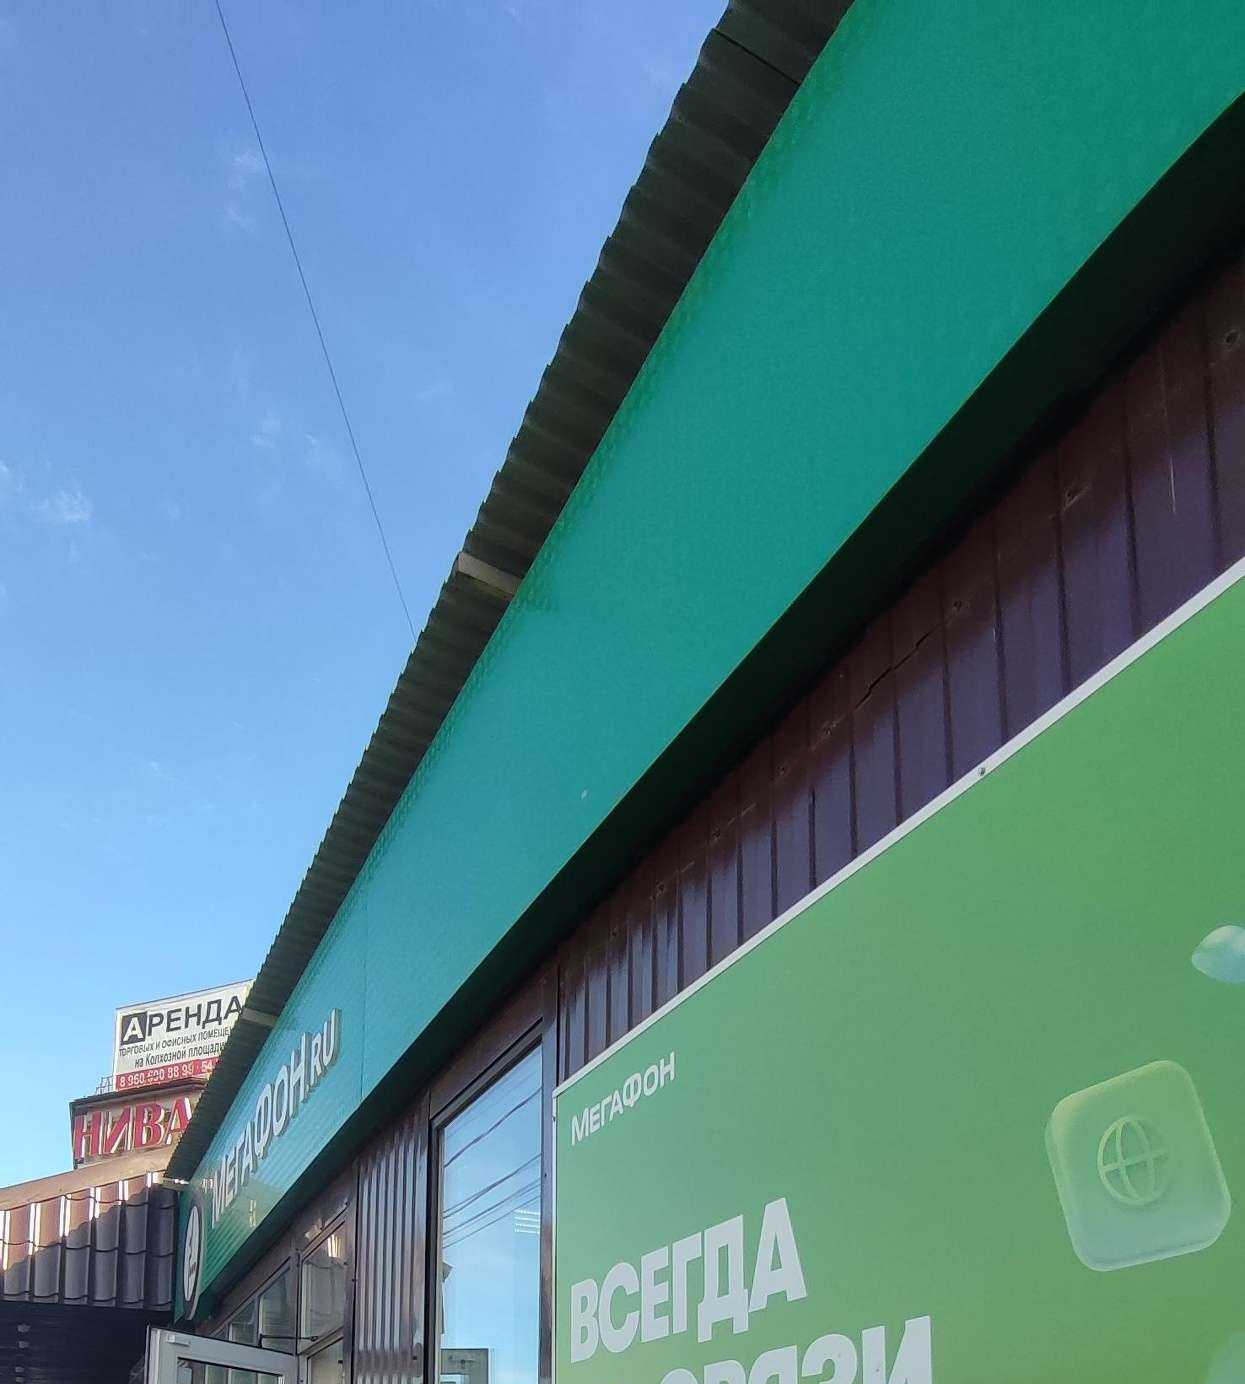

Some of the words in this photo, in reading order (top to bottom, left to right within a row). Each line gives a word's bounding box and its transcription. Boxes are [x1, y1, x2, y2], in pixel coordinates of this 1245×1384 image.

[121, 995, 242, 1043] АРЕНДА
[145, 1047, 187, 1065] Колхозной
[119, 1076, 126, 1087] 8
[74, 1097, 193, 1160] НИВА
[569, 1197, 808, 1364] ВСЕГДА
